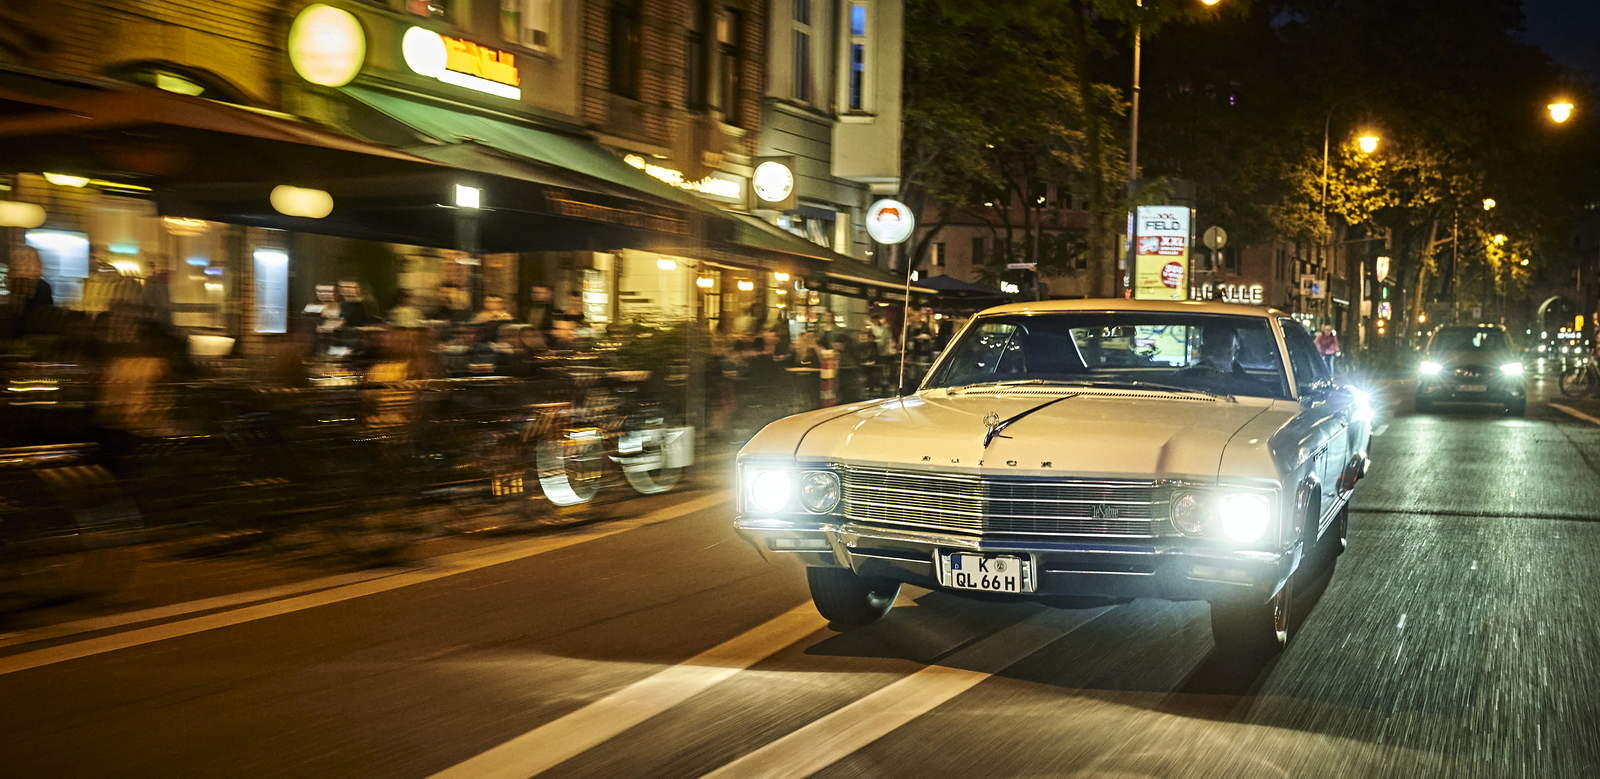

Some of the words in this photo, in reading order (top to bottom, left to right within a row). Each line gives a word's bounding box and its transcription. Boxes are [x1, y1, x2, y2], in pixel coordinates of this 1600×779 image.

[1145, 220, 1181, 231] FELD
[979, 558, 989, 572] K
[956, 573, 977, 588] QL
[981, 575, 1001, 590] 66
[1005, 576, 1015, 591] H
